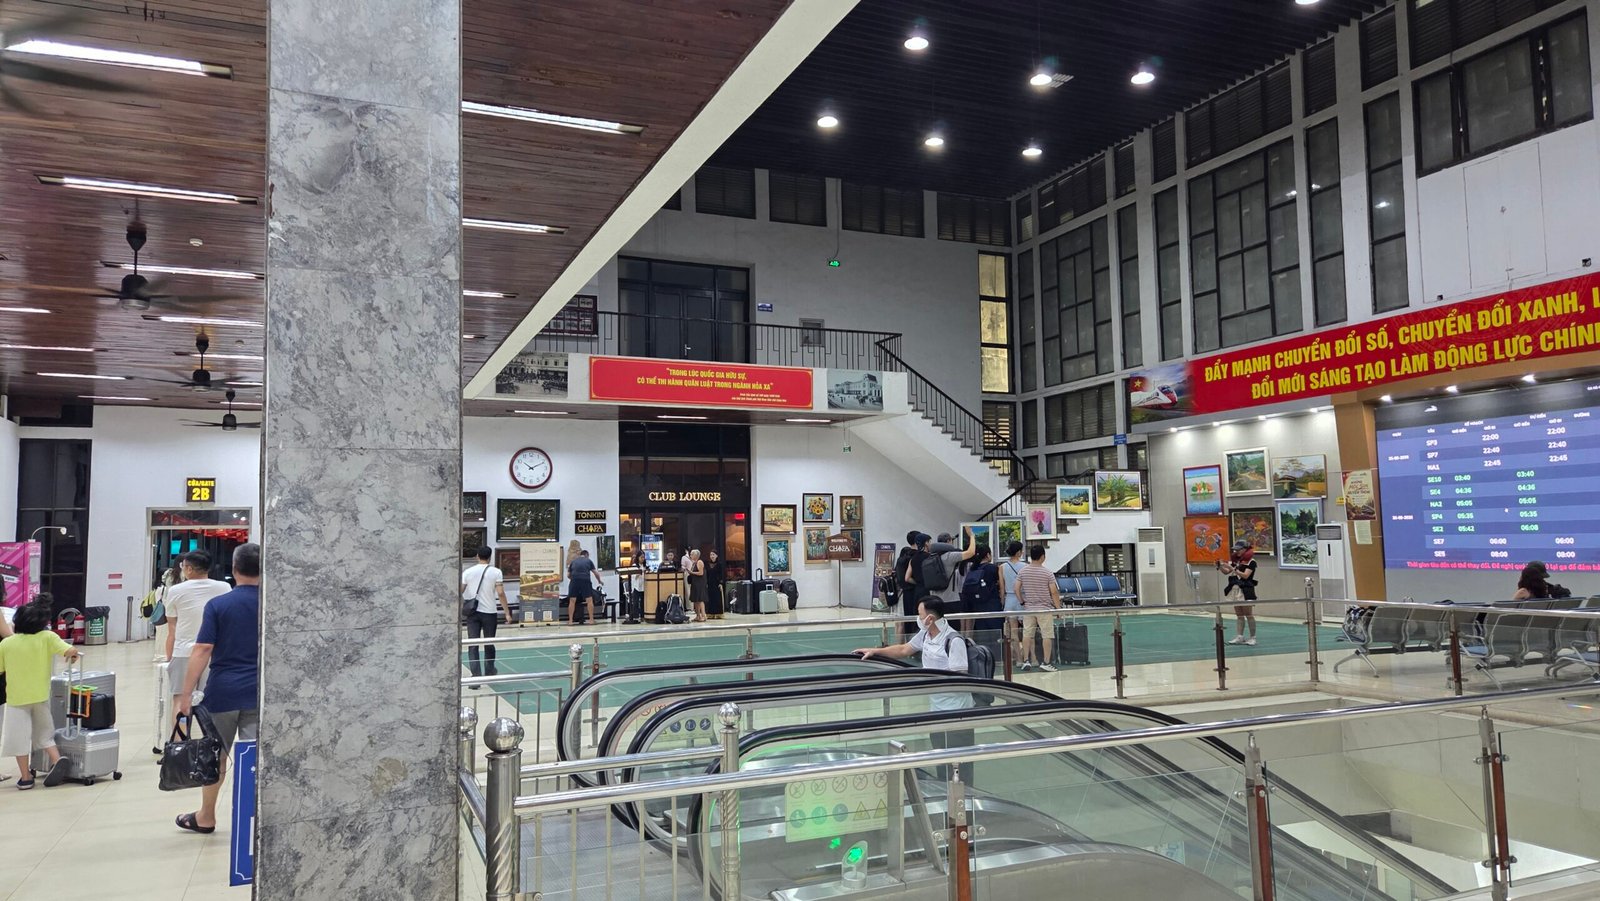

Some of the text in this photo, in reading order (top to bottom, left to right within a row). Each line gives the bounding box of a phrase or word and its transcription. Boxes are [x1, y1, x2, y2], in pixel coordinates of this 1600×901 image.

[1205, 358, 1228, 382] ĐẨY
[1232, 355, 1271, 378] MẠNH
[1274, 338, 1331, 368] CHUYỂN
[1335, 330, 1361, 357] ĐỔI
[1366, 324, 1394, 350] SỐ,
[1399, 309, 1472, 345] CHUYỂN
[1478, 299, 1512, 330] ĐỔI
[1518, 292, 1585, 323] XANH,
[1252, 375, 1274, 400] ĐỔI
[1278, 373, 1305, 395] MỚI
[1310, 366, 1351, 389] SÁNG
[1354, 361, 1385, 384] TẠO
[1391, 352, 1428, 376] LÀM
[1434, 343, 1487, 371] ĐỘNG
[1494, 334, 1532, 362] LỰC
[700, 370, 714, 378] QUỐC
[668, 378, 683, 386] HÀNH
[1547, 427, 1566, 435] 22:00
[192, 488, 210, 500] 2B
[649, 492, 721, 501] CLUB LOUNGE
